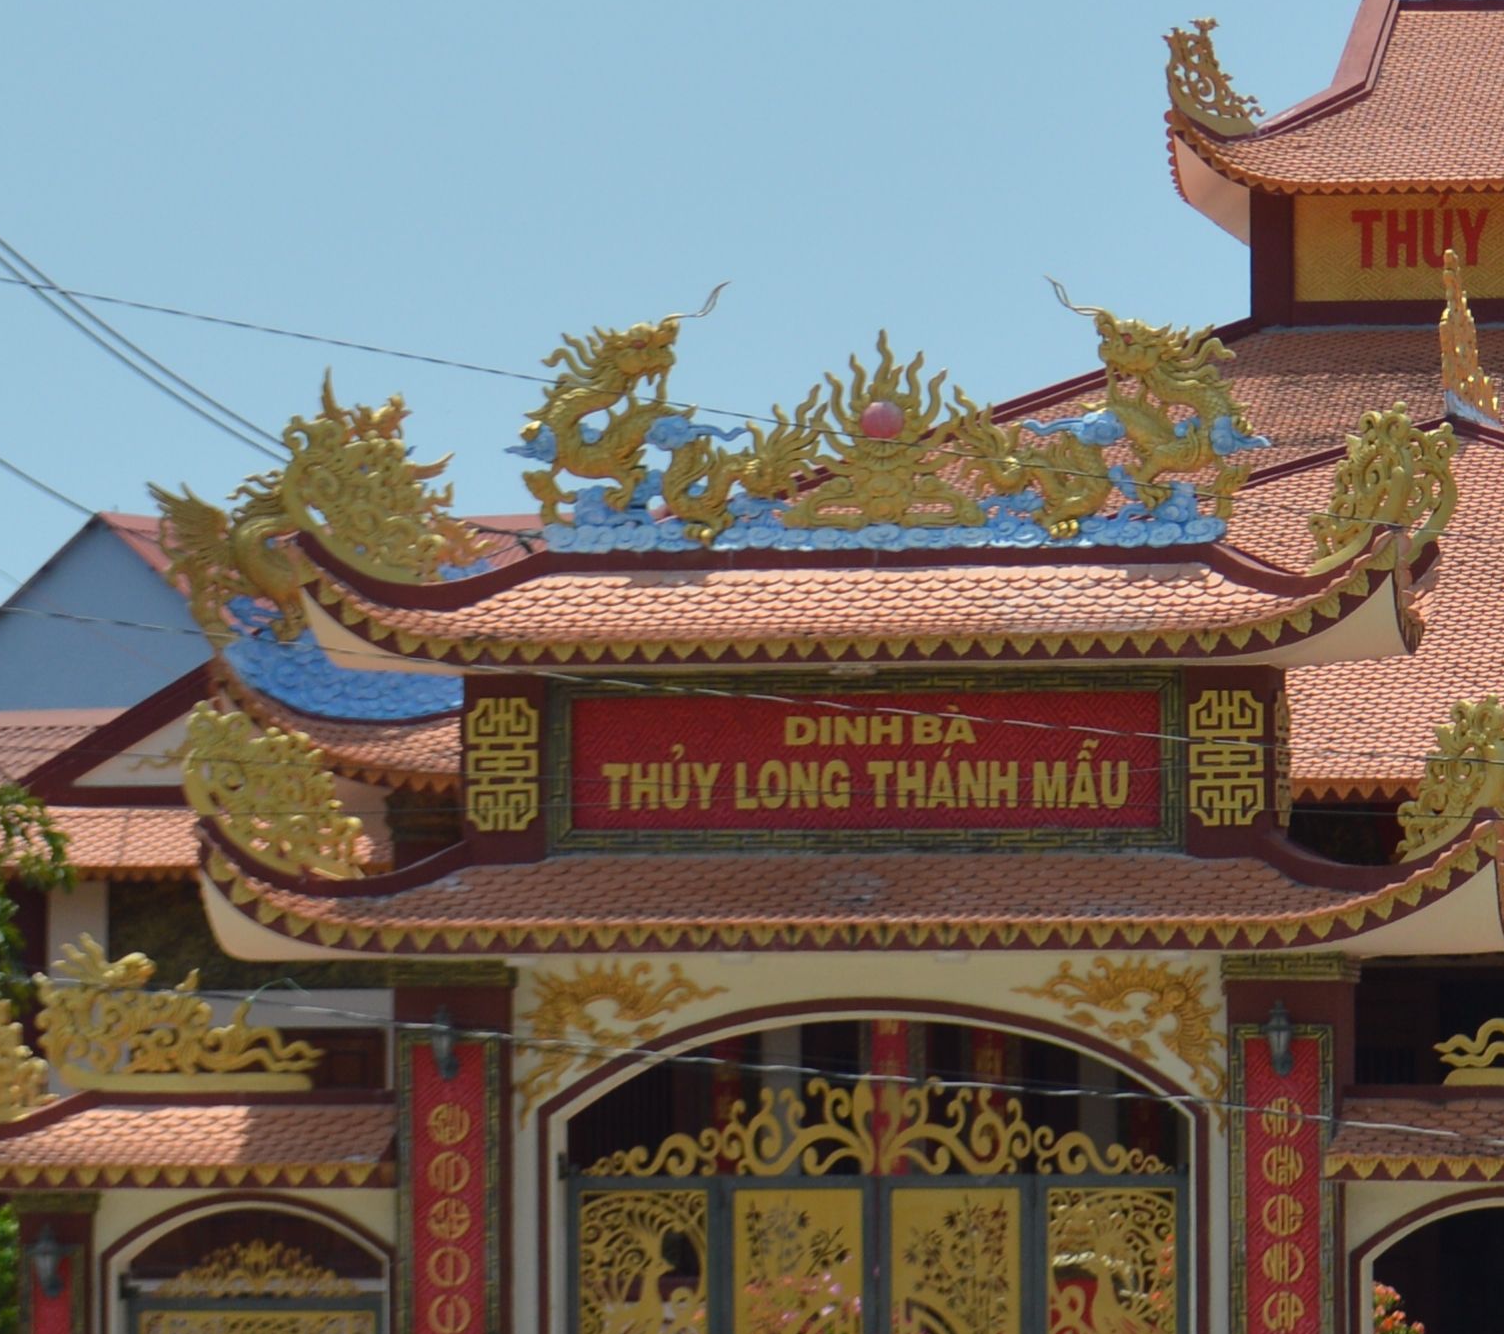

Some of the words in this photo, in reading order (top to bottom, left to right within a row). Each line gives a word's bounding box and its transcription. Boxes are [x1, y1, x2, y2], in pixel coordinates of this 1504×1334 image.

[784, 715, 903, 747] DINH
[911, 704, 977, 745] BÀ
[601, 743, 722, 811] THỦY
[735, 759, 851, 810] LONG
[866, 746, 1019, 810] THÁNH
[1032, 737, 1130, 810] MẪU
